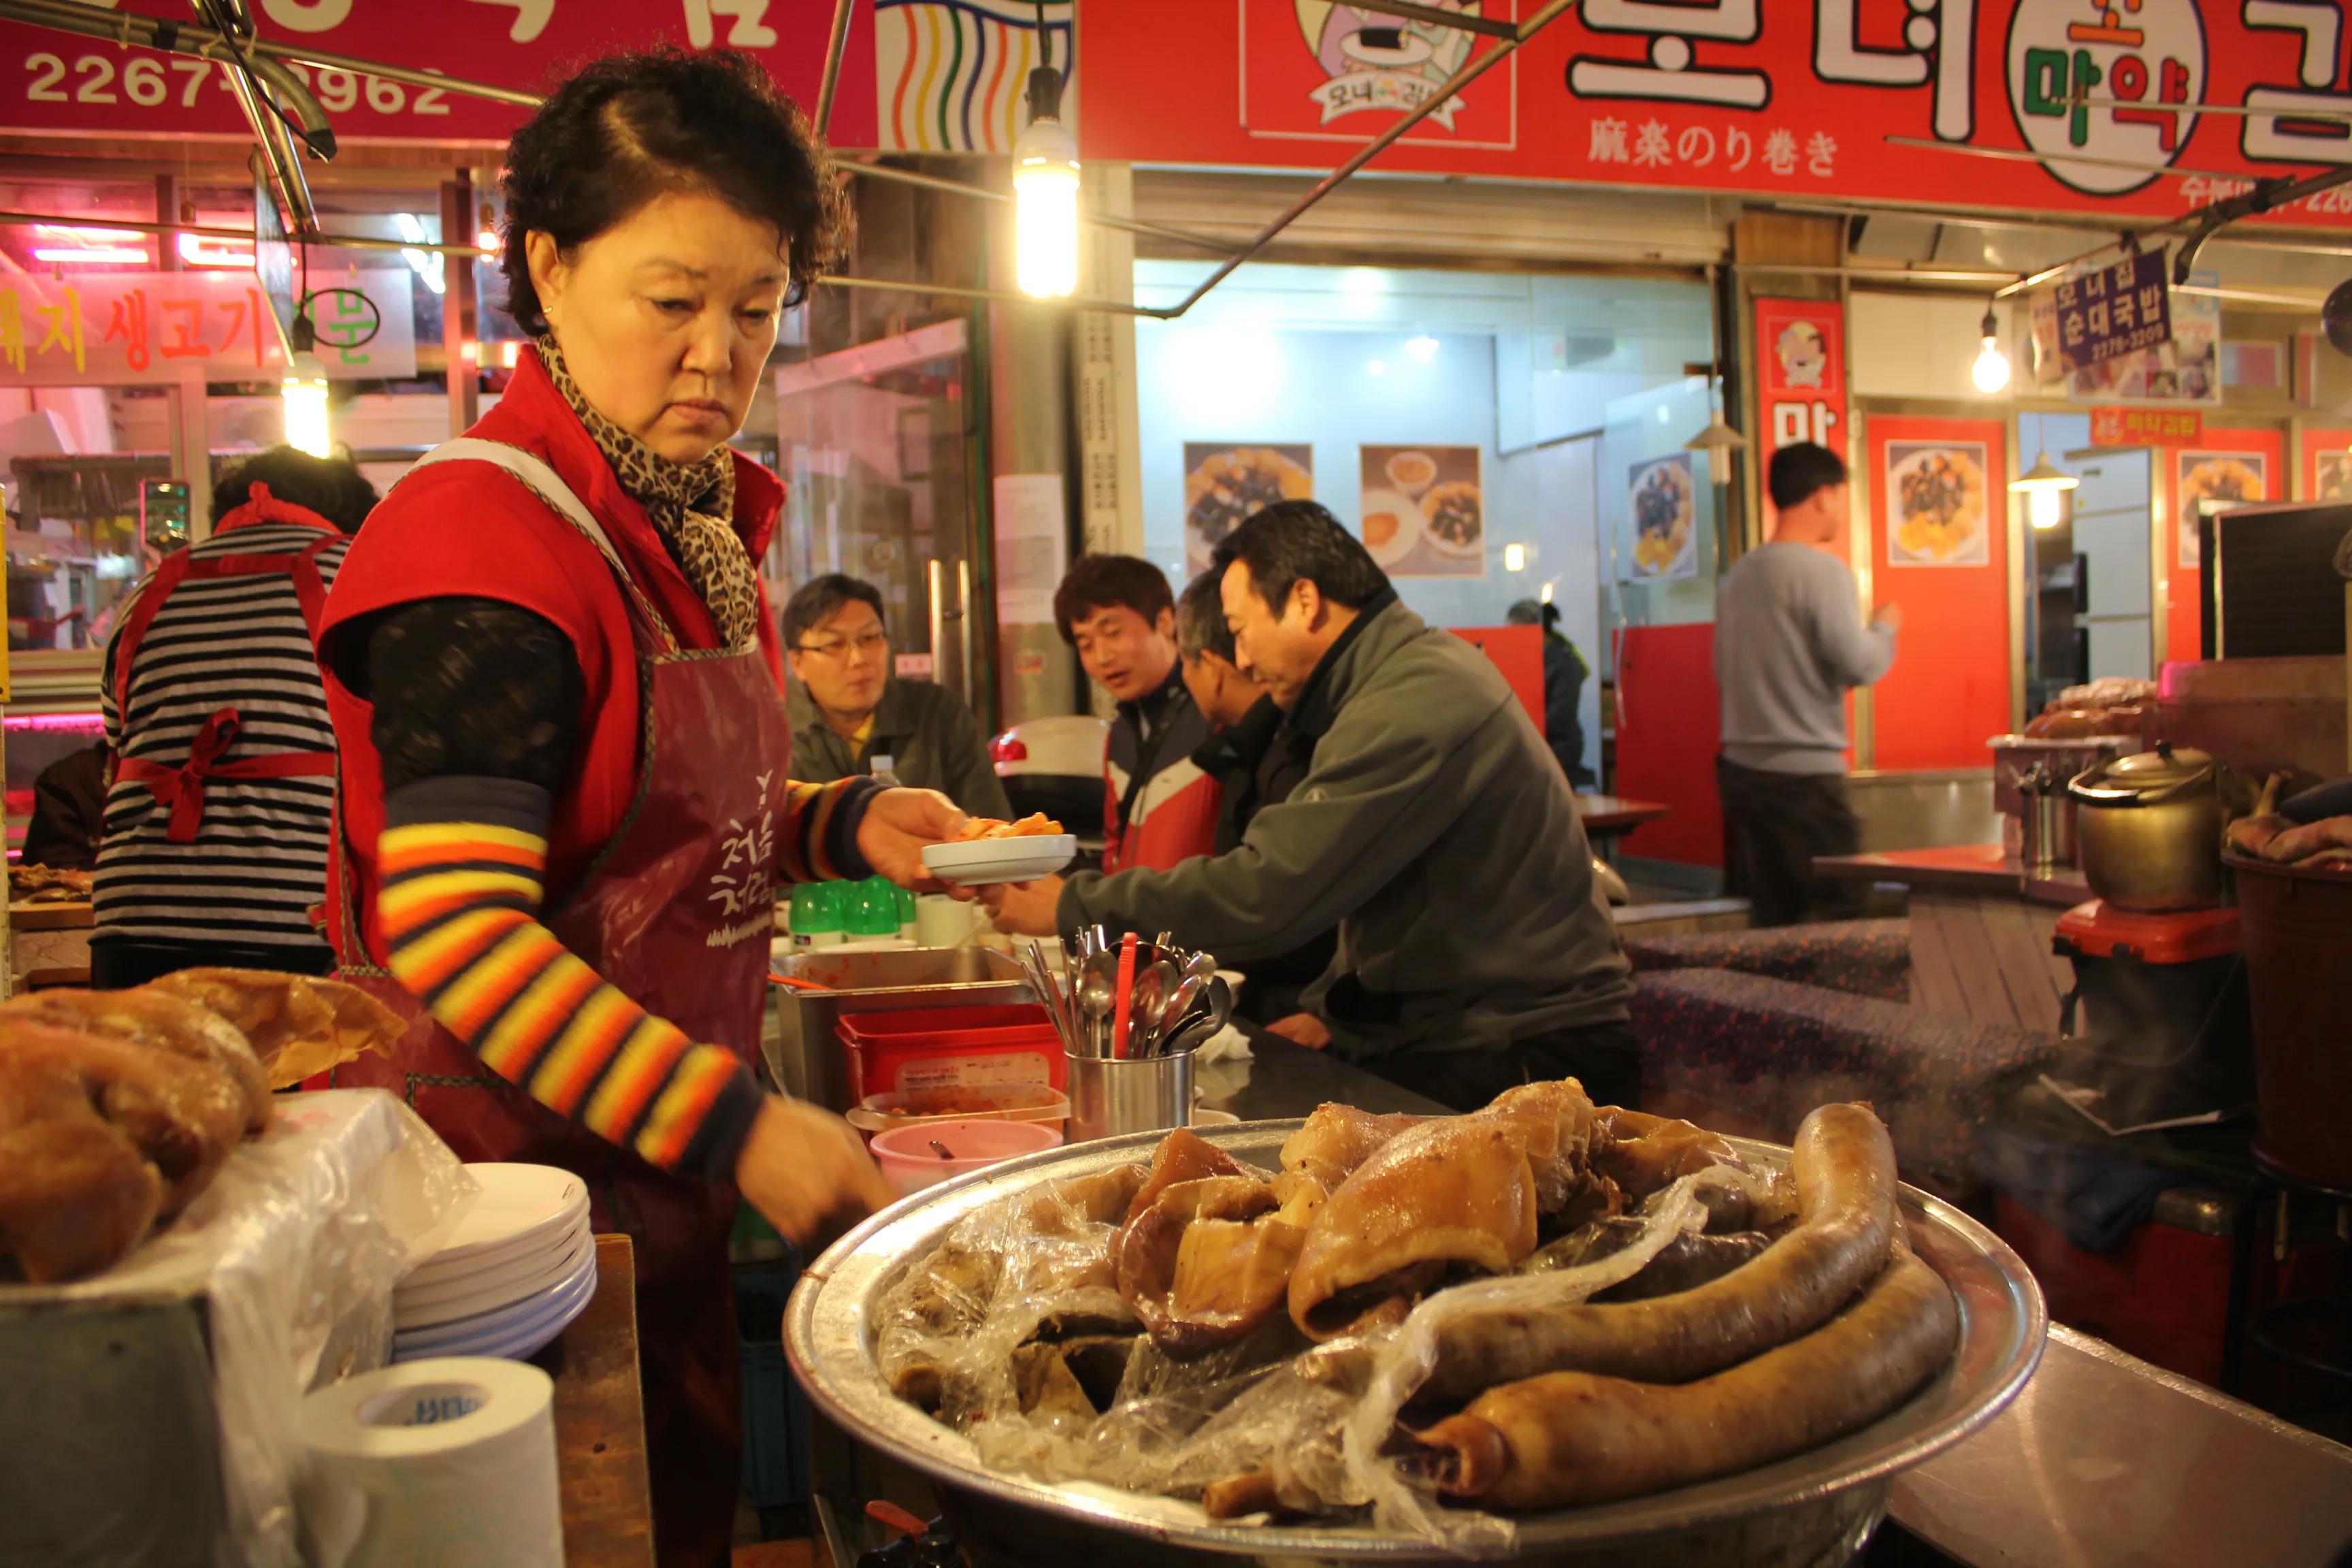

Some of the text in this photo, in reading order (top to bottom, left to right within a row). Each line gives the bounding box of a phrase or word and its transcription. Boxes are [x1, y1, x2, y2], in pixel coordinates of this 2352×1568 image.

[1329, 78, 1373, 110] 모녀
[2023, 46, 2189, 154] 마약
[1588, 116, 1838, 177] 麻楽のり巻き
[103, 288, 265, 372] 생고기
[2063, 282, 2162, 347] 순대국밥
